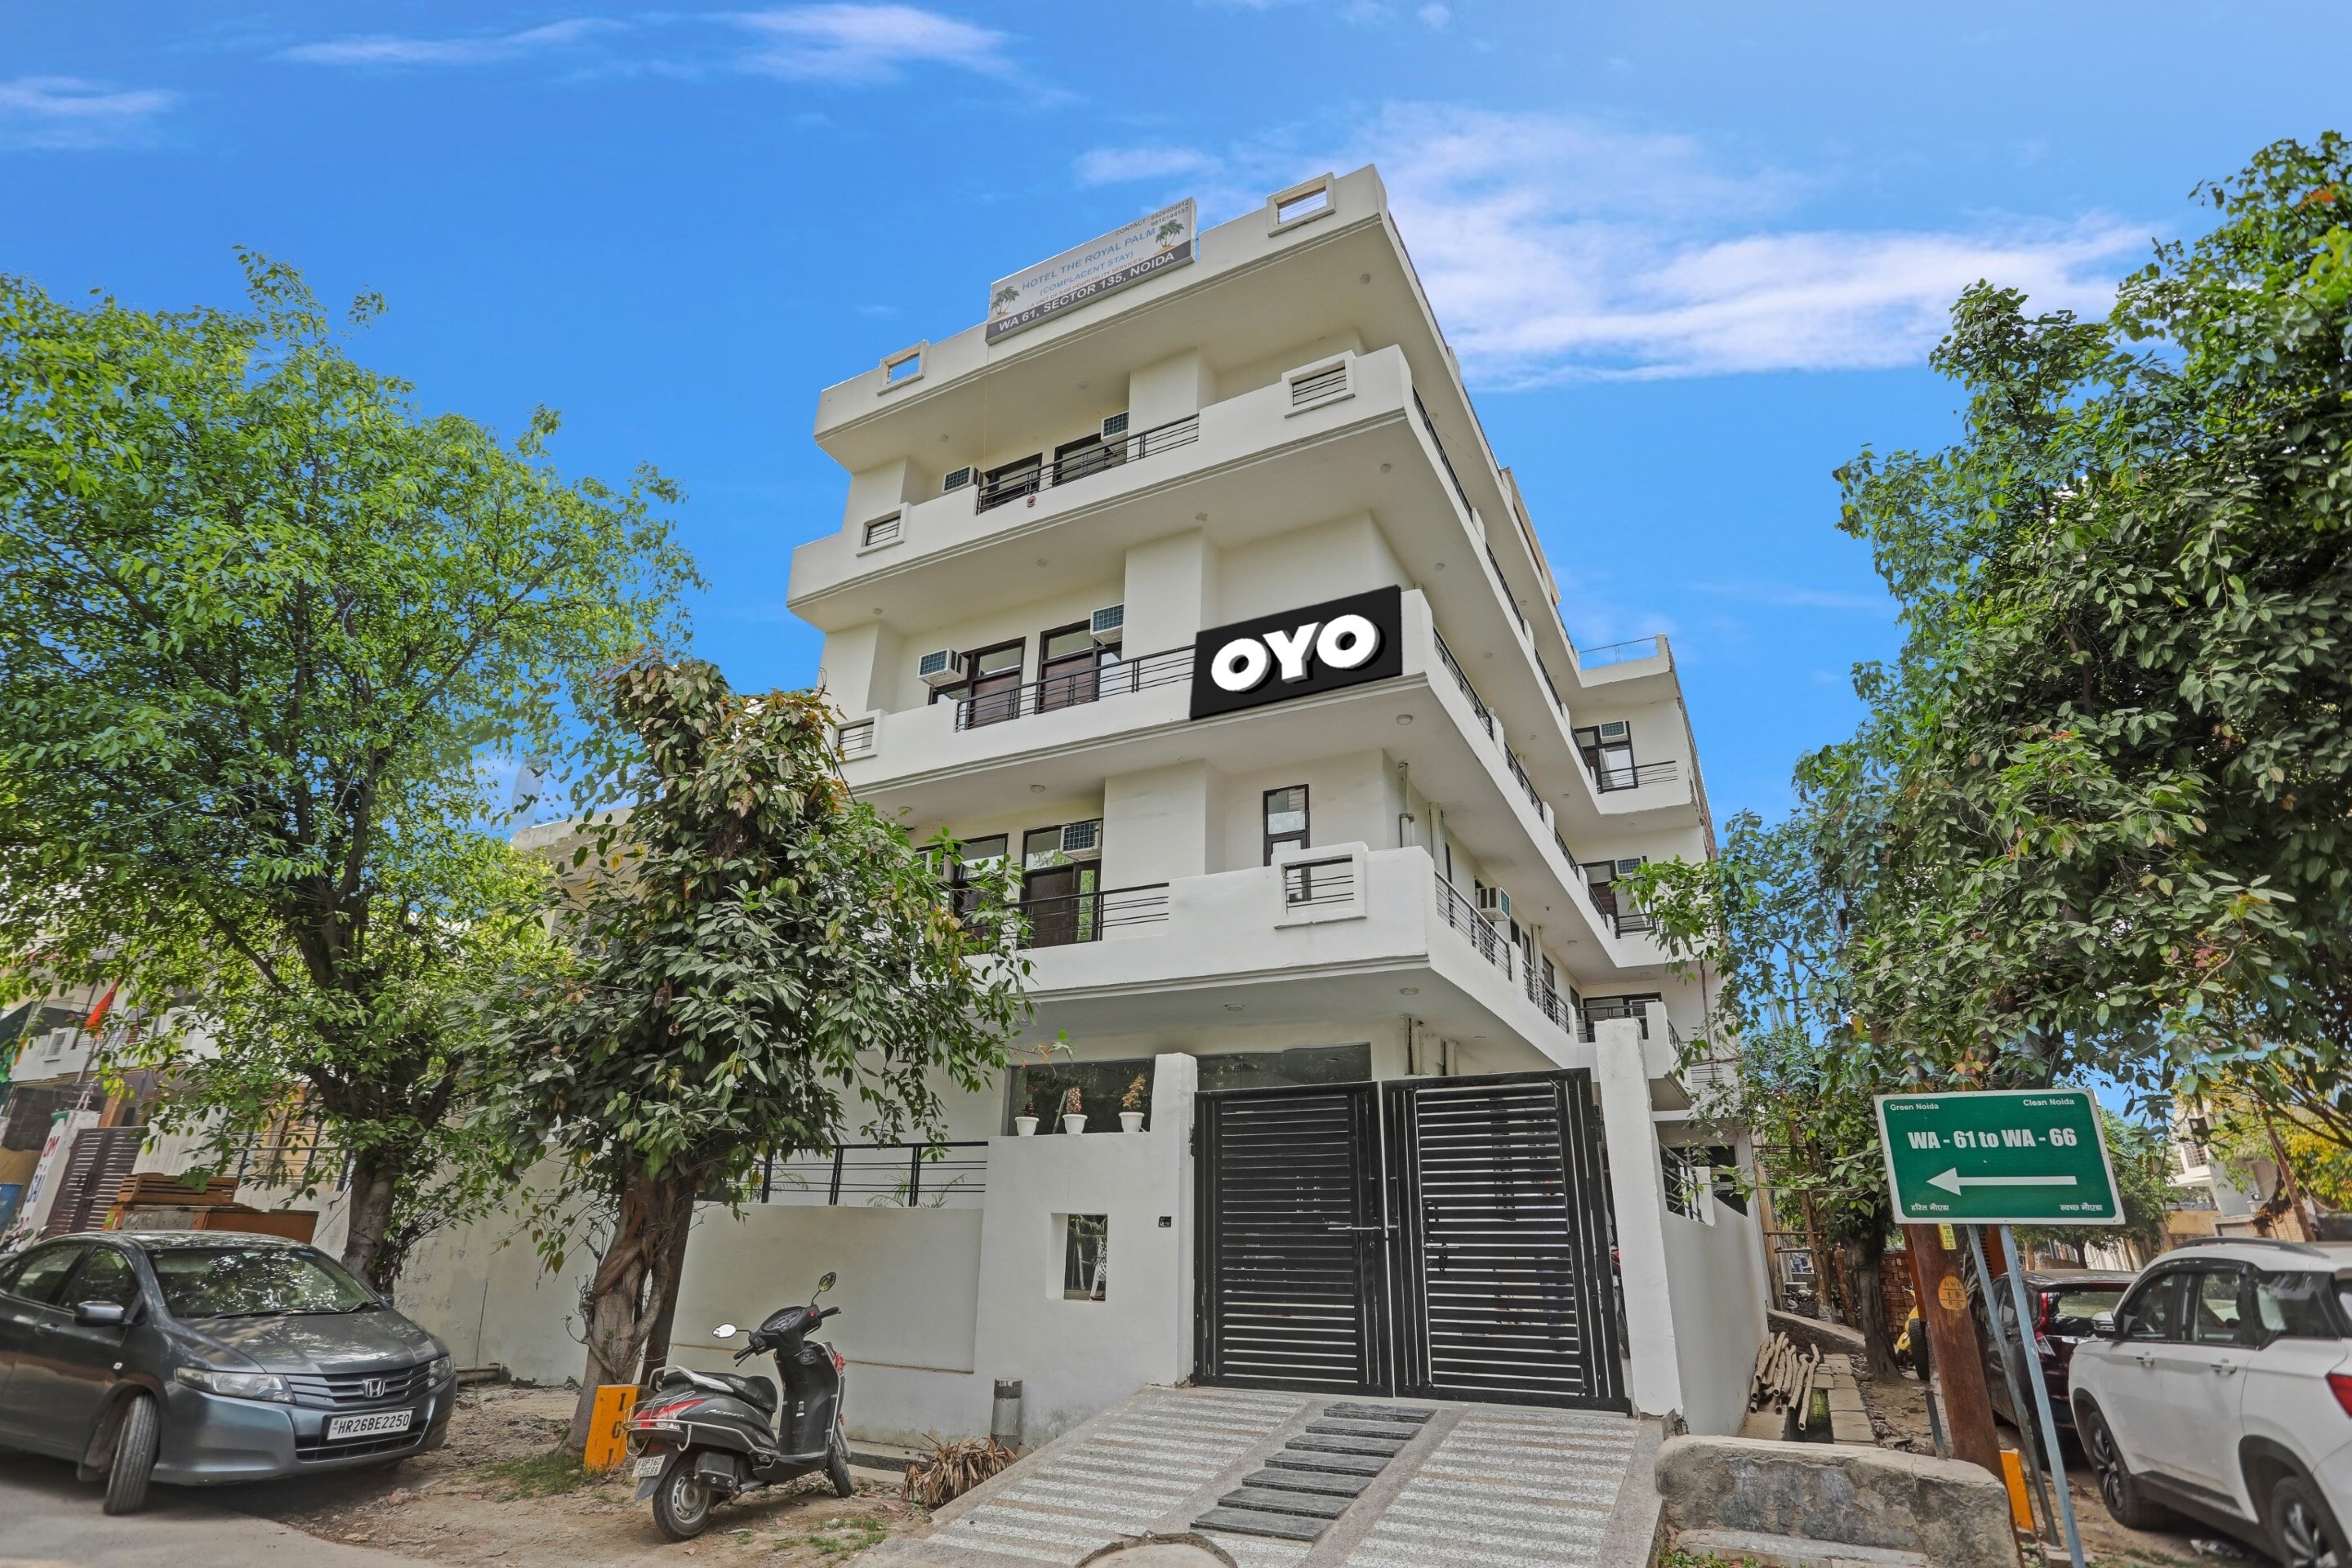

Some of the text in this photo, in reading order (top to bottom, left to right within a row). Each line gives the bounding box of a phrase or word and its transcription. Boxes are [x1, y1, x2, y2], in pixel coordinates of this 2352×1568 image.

[1022, 227, 1156, 291] HOTEL THE ROYAL PALM
[1040, 250, 1134, 296] (COMPLACENT STAY)
[998, 252, 1174, 332] WA 61, SECTOR 135, NOIDA
[1211, 614, 1380, 692] OYO
[1890, 1102, 1940, 1111] Green Noida
[2023, 1098, 2075, 1107] Clean Noida
[1907, 1131, 1941, 1150] WA
[1953, 1130, 1977, 1149] 61
[1978, 1131, 2000, 1148] to
[2001, 1129, 2037, 1147] WA
[2049, 1128, 2078, 1147] 66
[337, 1414, 410, 1434] HR26BE2250
